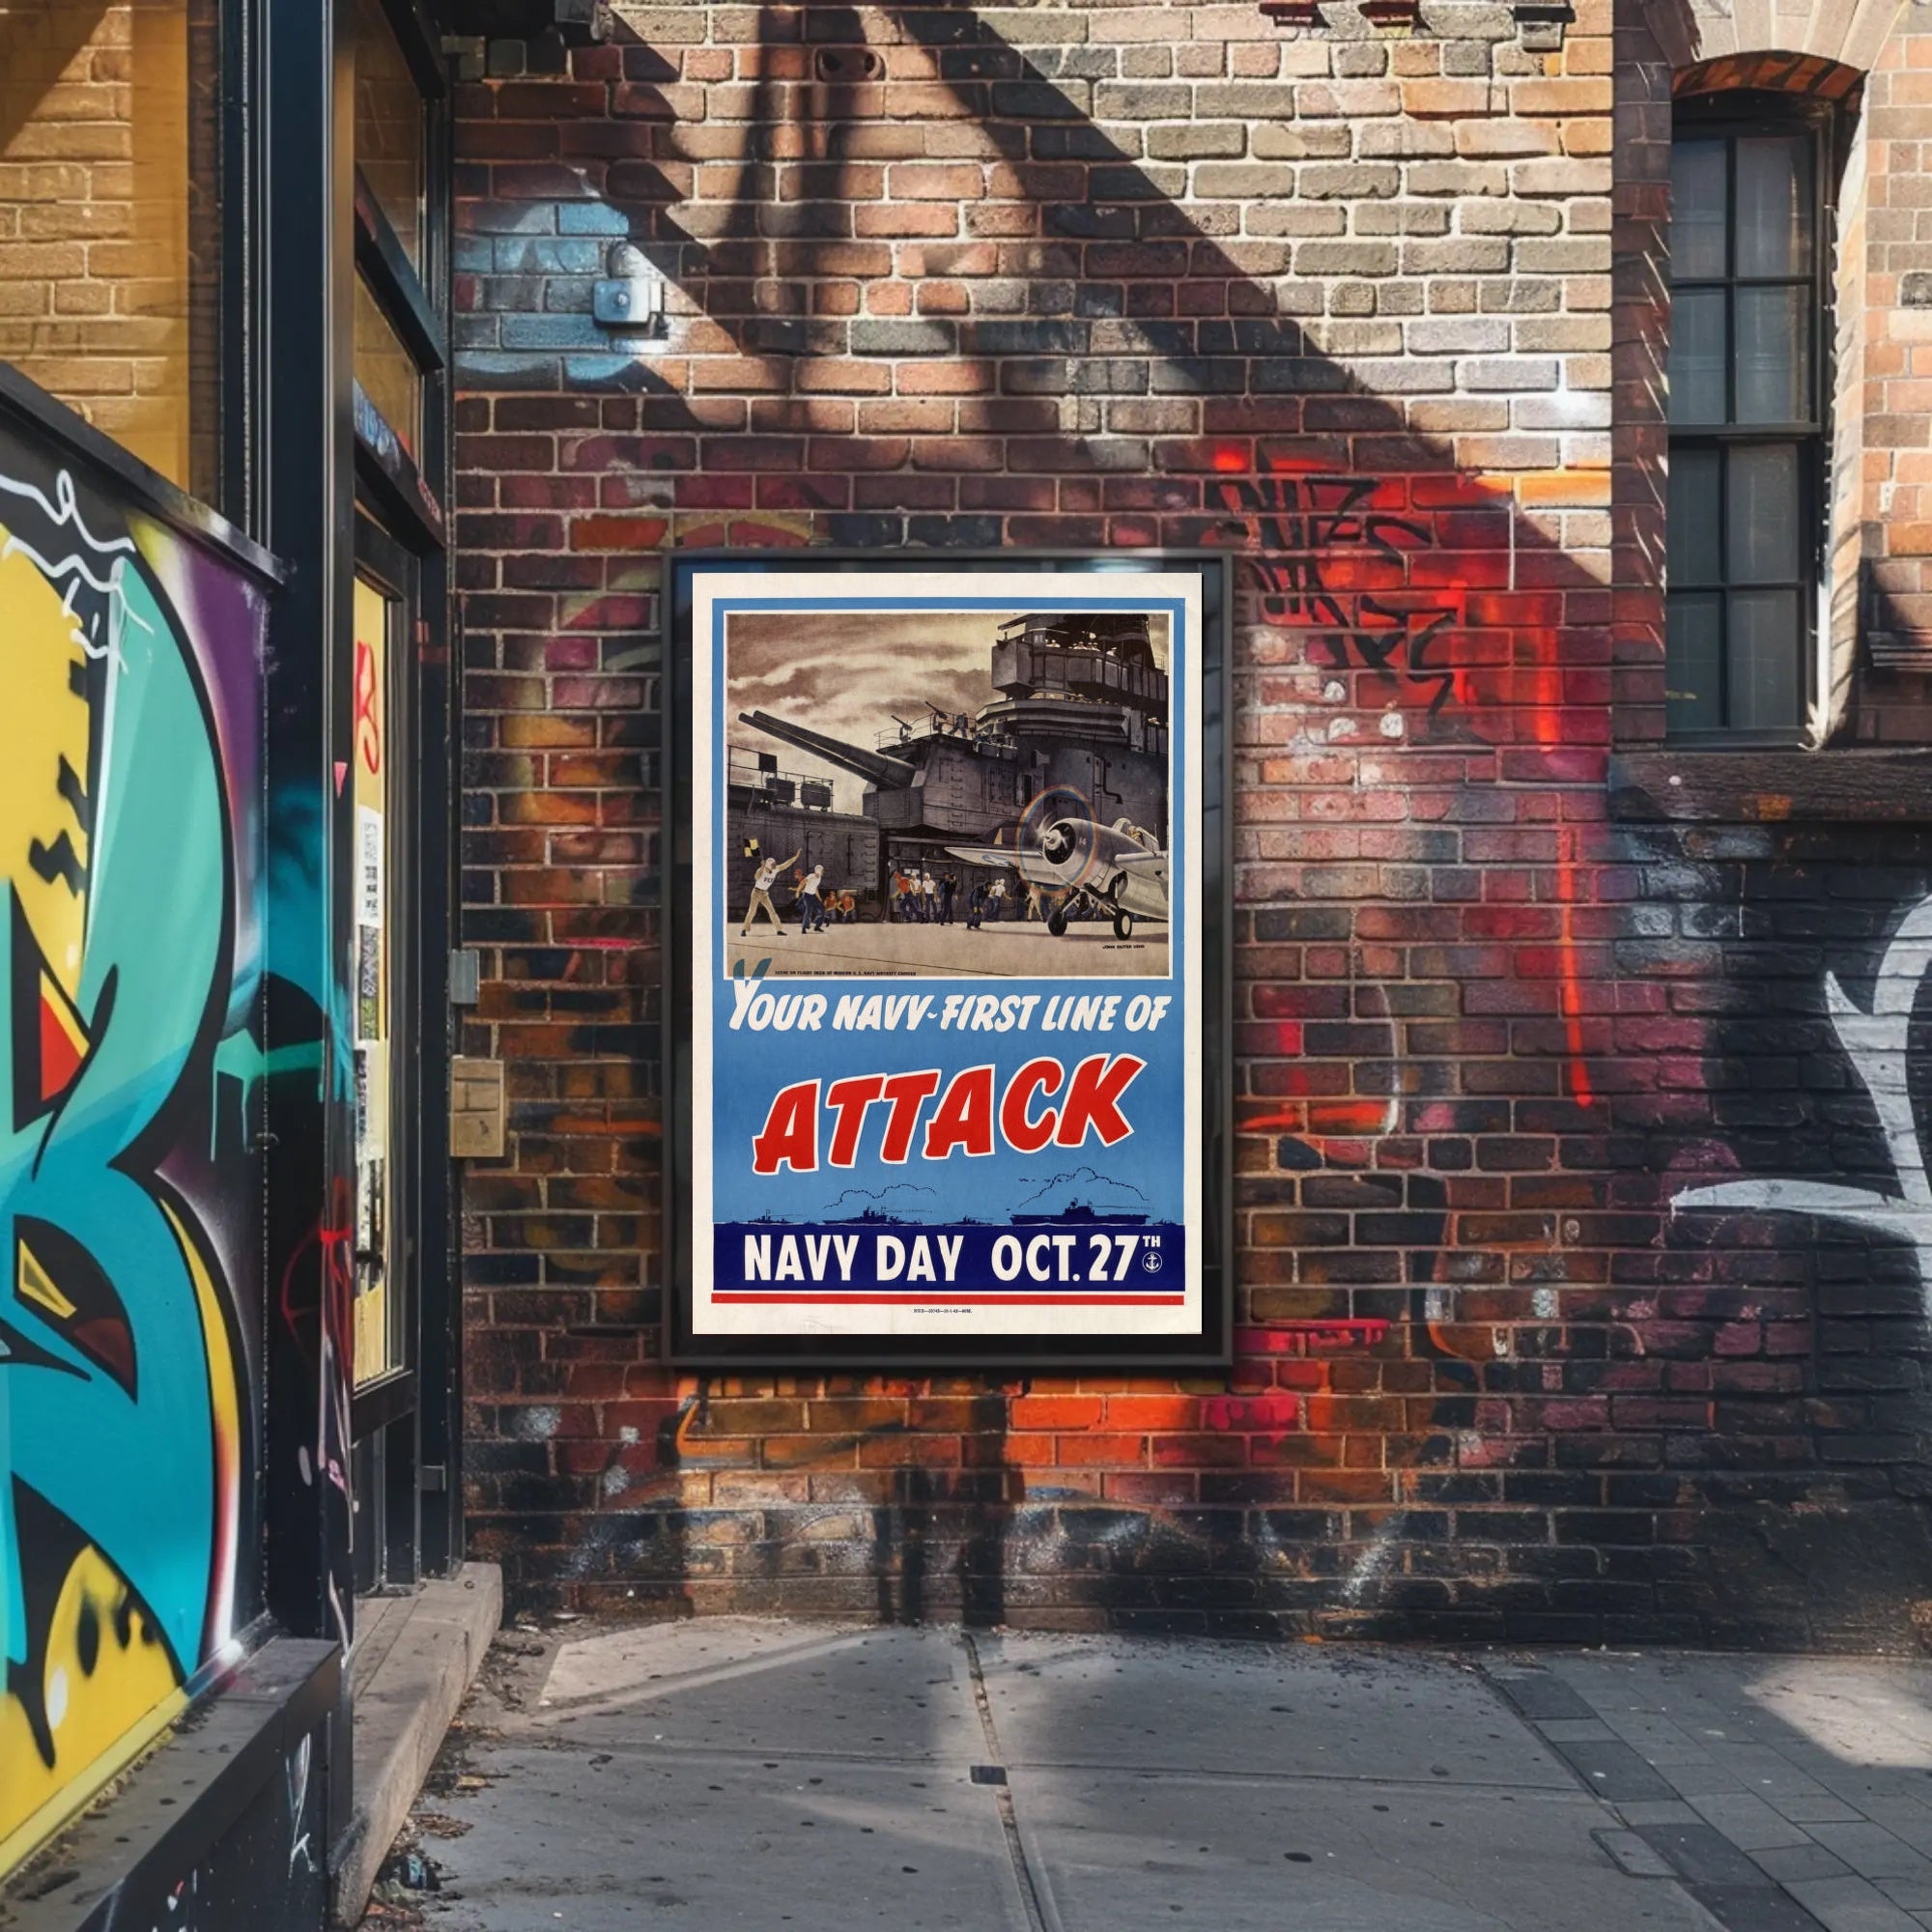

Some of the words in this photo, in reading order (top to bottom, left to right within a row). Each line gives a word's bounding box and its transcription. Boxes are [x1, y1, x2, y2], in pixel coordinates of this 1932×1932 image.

[729, 957, 824, 1031] YOUR
[1041, 996, 1118, 1031] LINE
[1125, 995, 1172, 1032] OF
[753, 1053, 1148, 1176] ATTACK
[745, 1236, 859, 1280] NAVY
[877, 1236, 963, 1281] DAY
[992, 1235, 1079, 1281] OCT.
